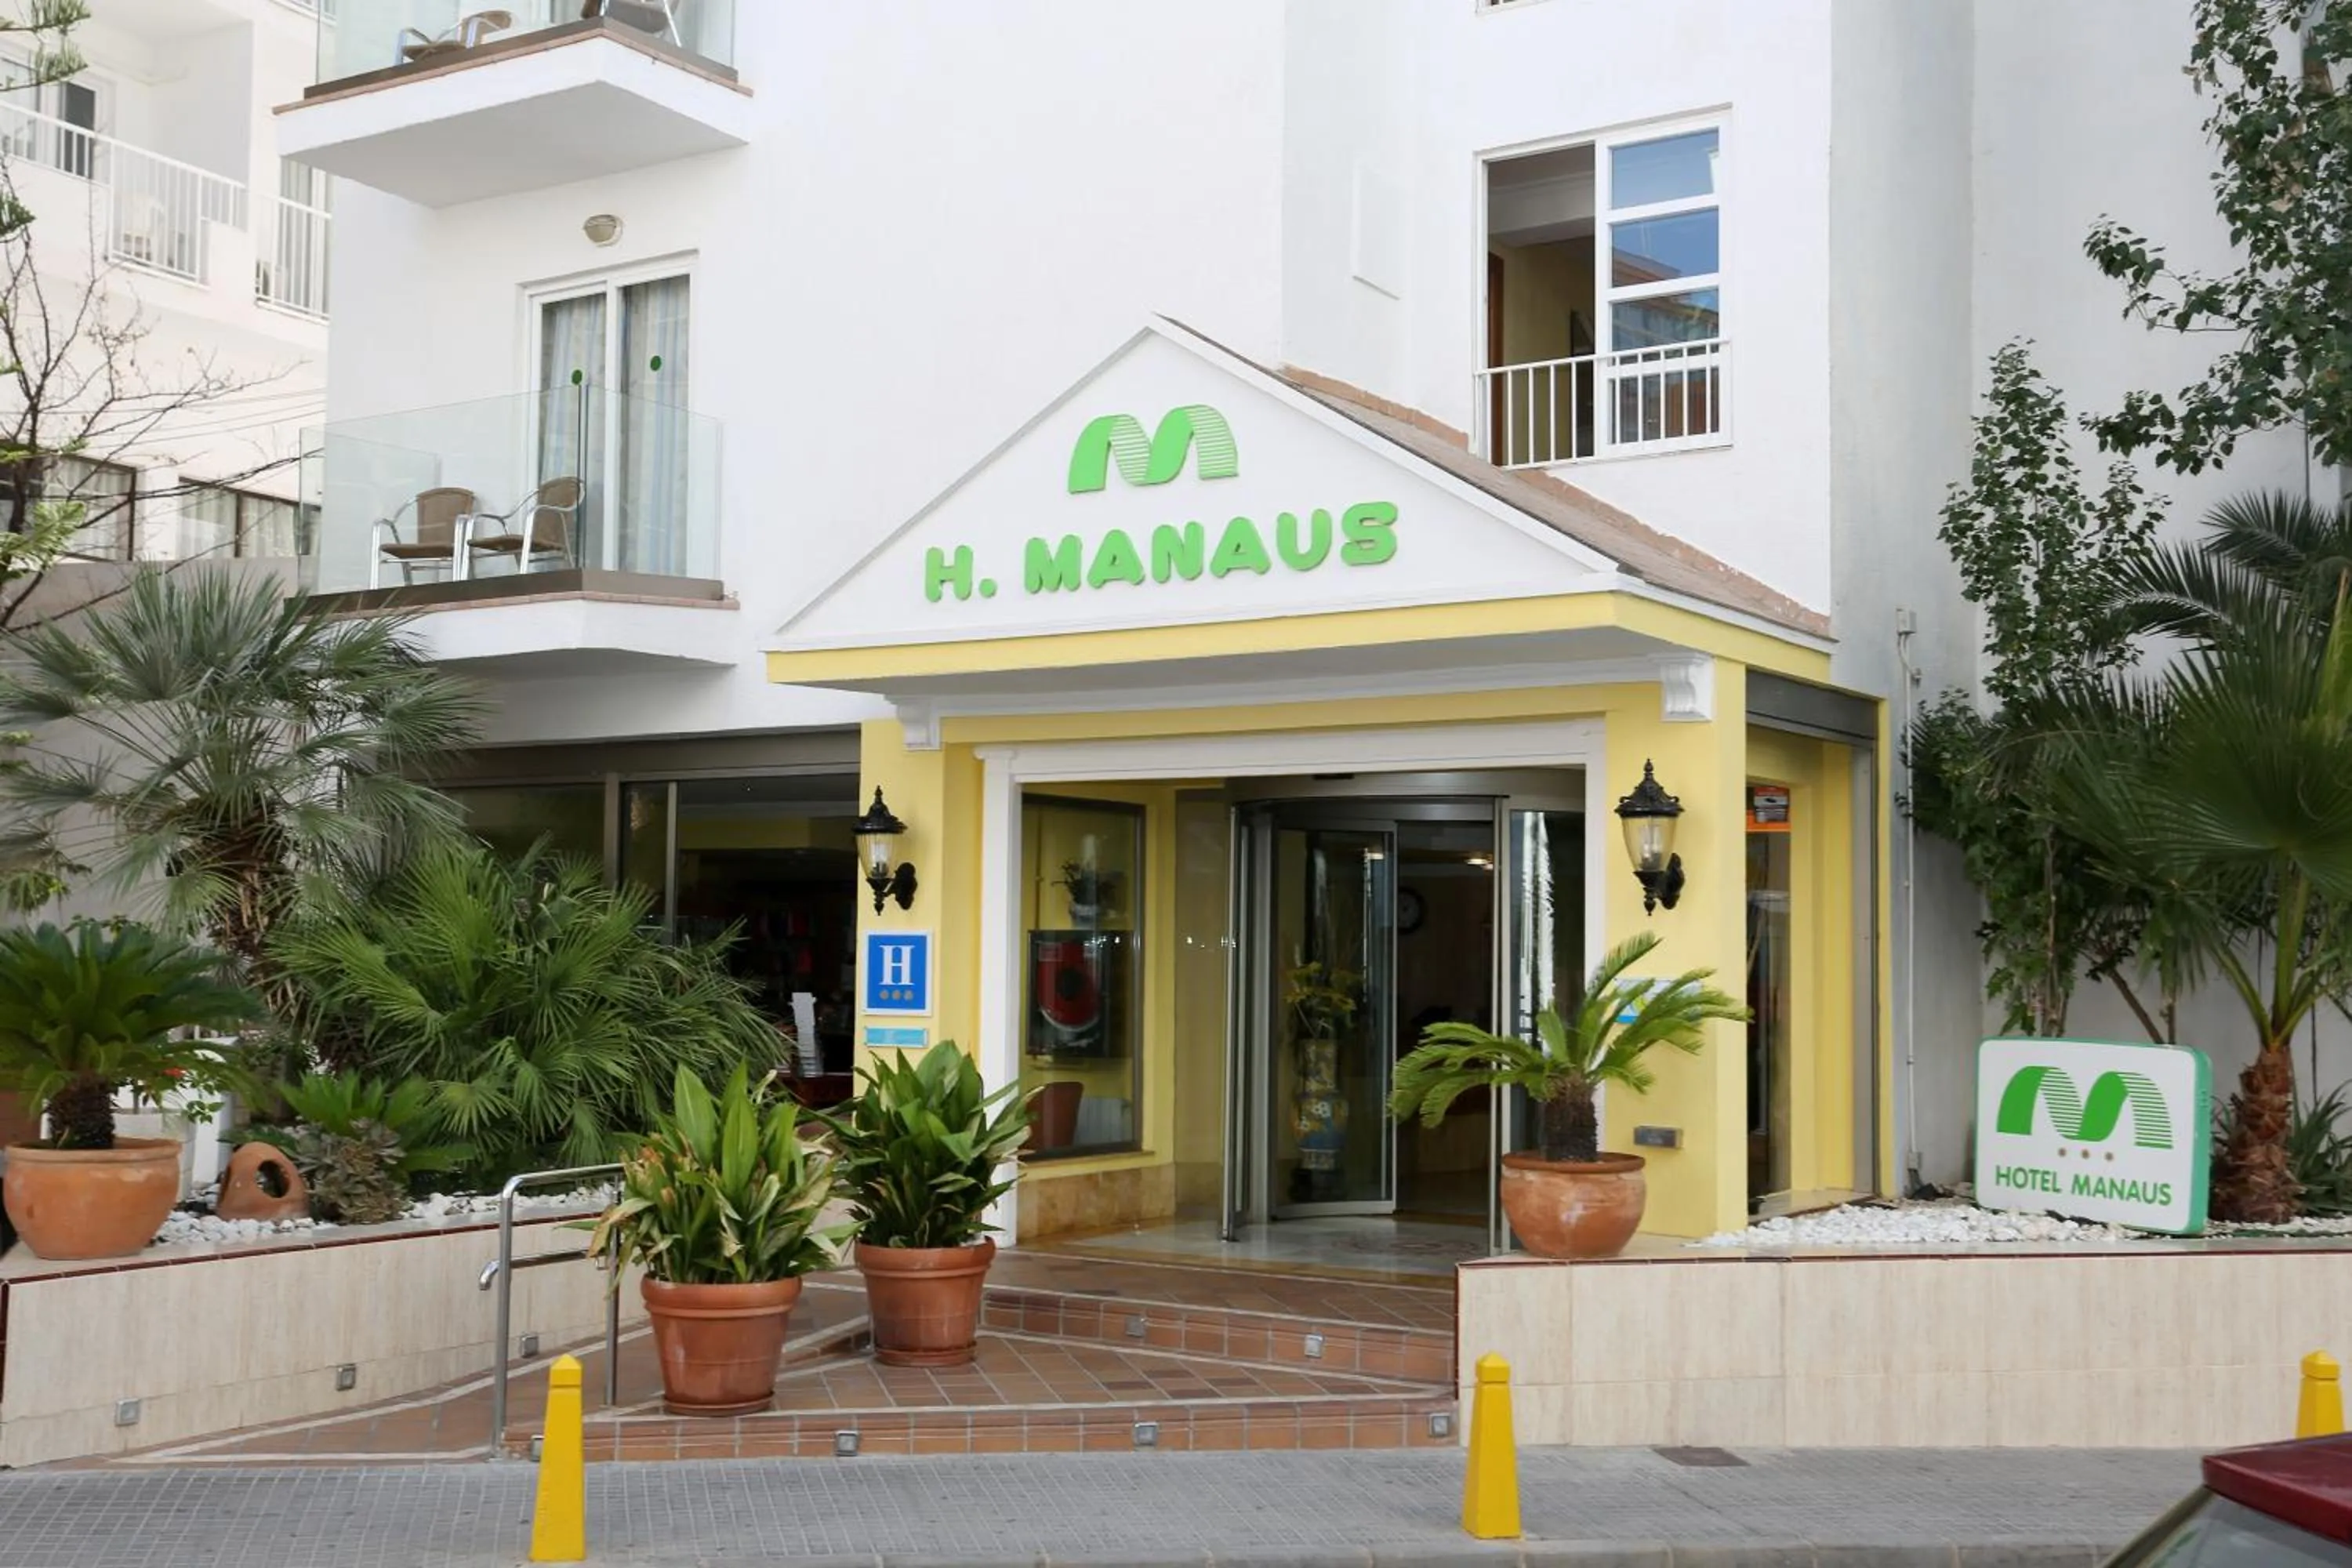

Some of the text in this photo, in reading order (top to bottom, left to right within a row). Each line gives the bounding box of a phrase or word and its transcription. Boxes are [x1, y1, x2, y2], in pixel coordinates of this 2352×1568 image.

[924, 500, 1399, 603] H. MANAUS
[878, 944, 916, 985] H
[1994, 1165, 2172, 1207] HOTEL MANAUS
